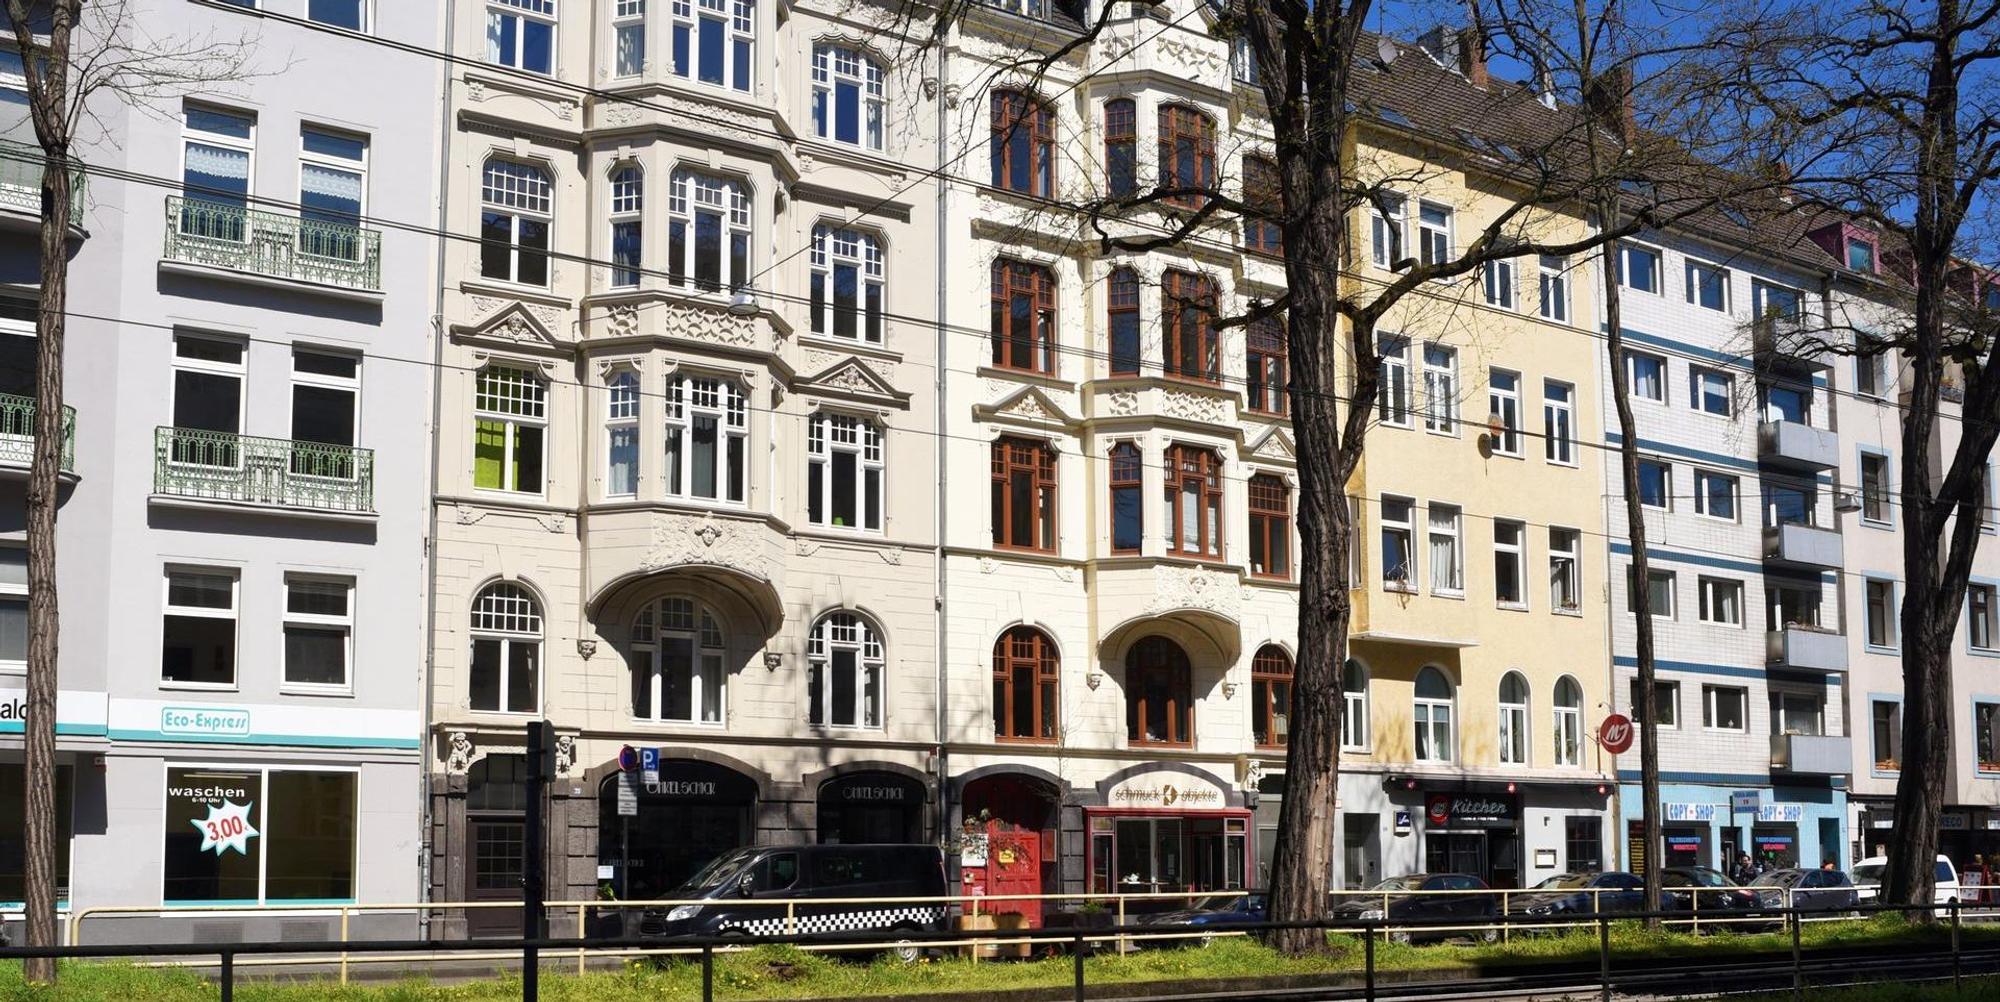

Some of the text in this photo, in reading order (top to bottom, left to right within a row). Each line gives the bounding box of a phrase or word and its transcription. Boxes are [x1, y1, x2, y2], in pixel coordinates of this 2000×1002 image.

[165, 712, 247, 731] Eco-Express
[643, 751, 654, 769] P
[169, 786, 245, 798] waschen
[1115, 785, 1218, 804] schmuck objekte
[1451, 799, 1508, 814] Kitchen
[1669, 804, 1714, 820] COPY SHOP
[1760, 805, 1778, 821] COPY
[1784, 805, 1801, 821] SHOP
[207, 815, 243, 842] 3,00
